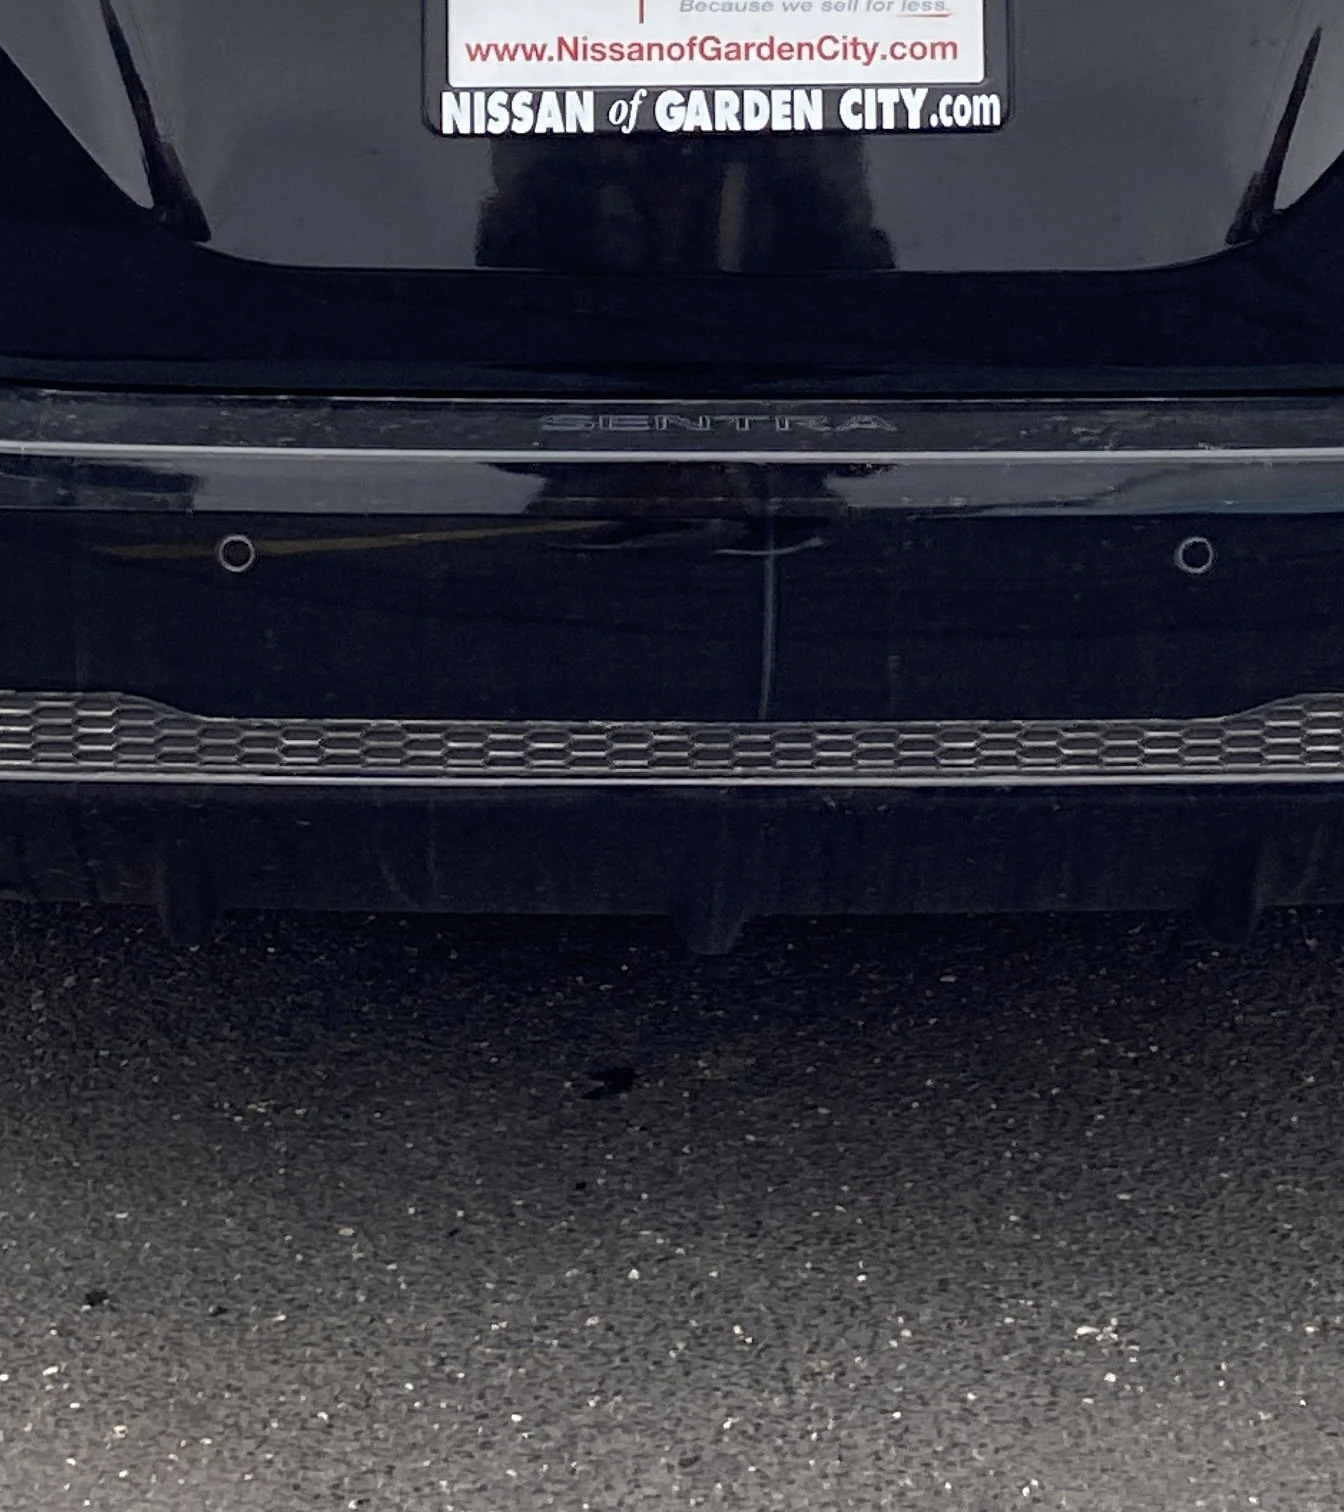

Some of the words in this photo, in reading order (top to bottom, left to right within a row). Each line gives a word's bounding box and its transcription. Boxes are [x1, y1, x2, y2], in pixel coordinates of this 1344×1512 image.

[782, 1, 813, 13] we
[465, 35, 959, 67] www.NissanofGardenCity.com
[441, 90, 595, 135] NISSAN
[608, 88, 648, 134] of
[655, 89, 824, 133] GARDEN
[838, 87, 1001, 131] CITY.com
[541, 414, 898, 432] SENTRA
